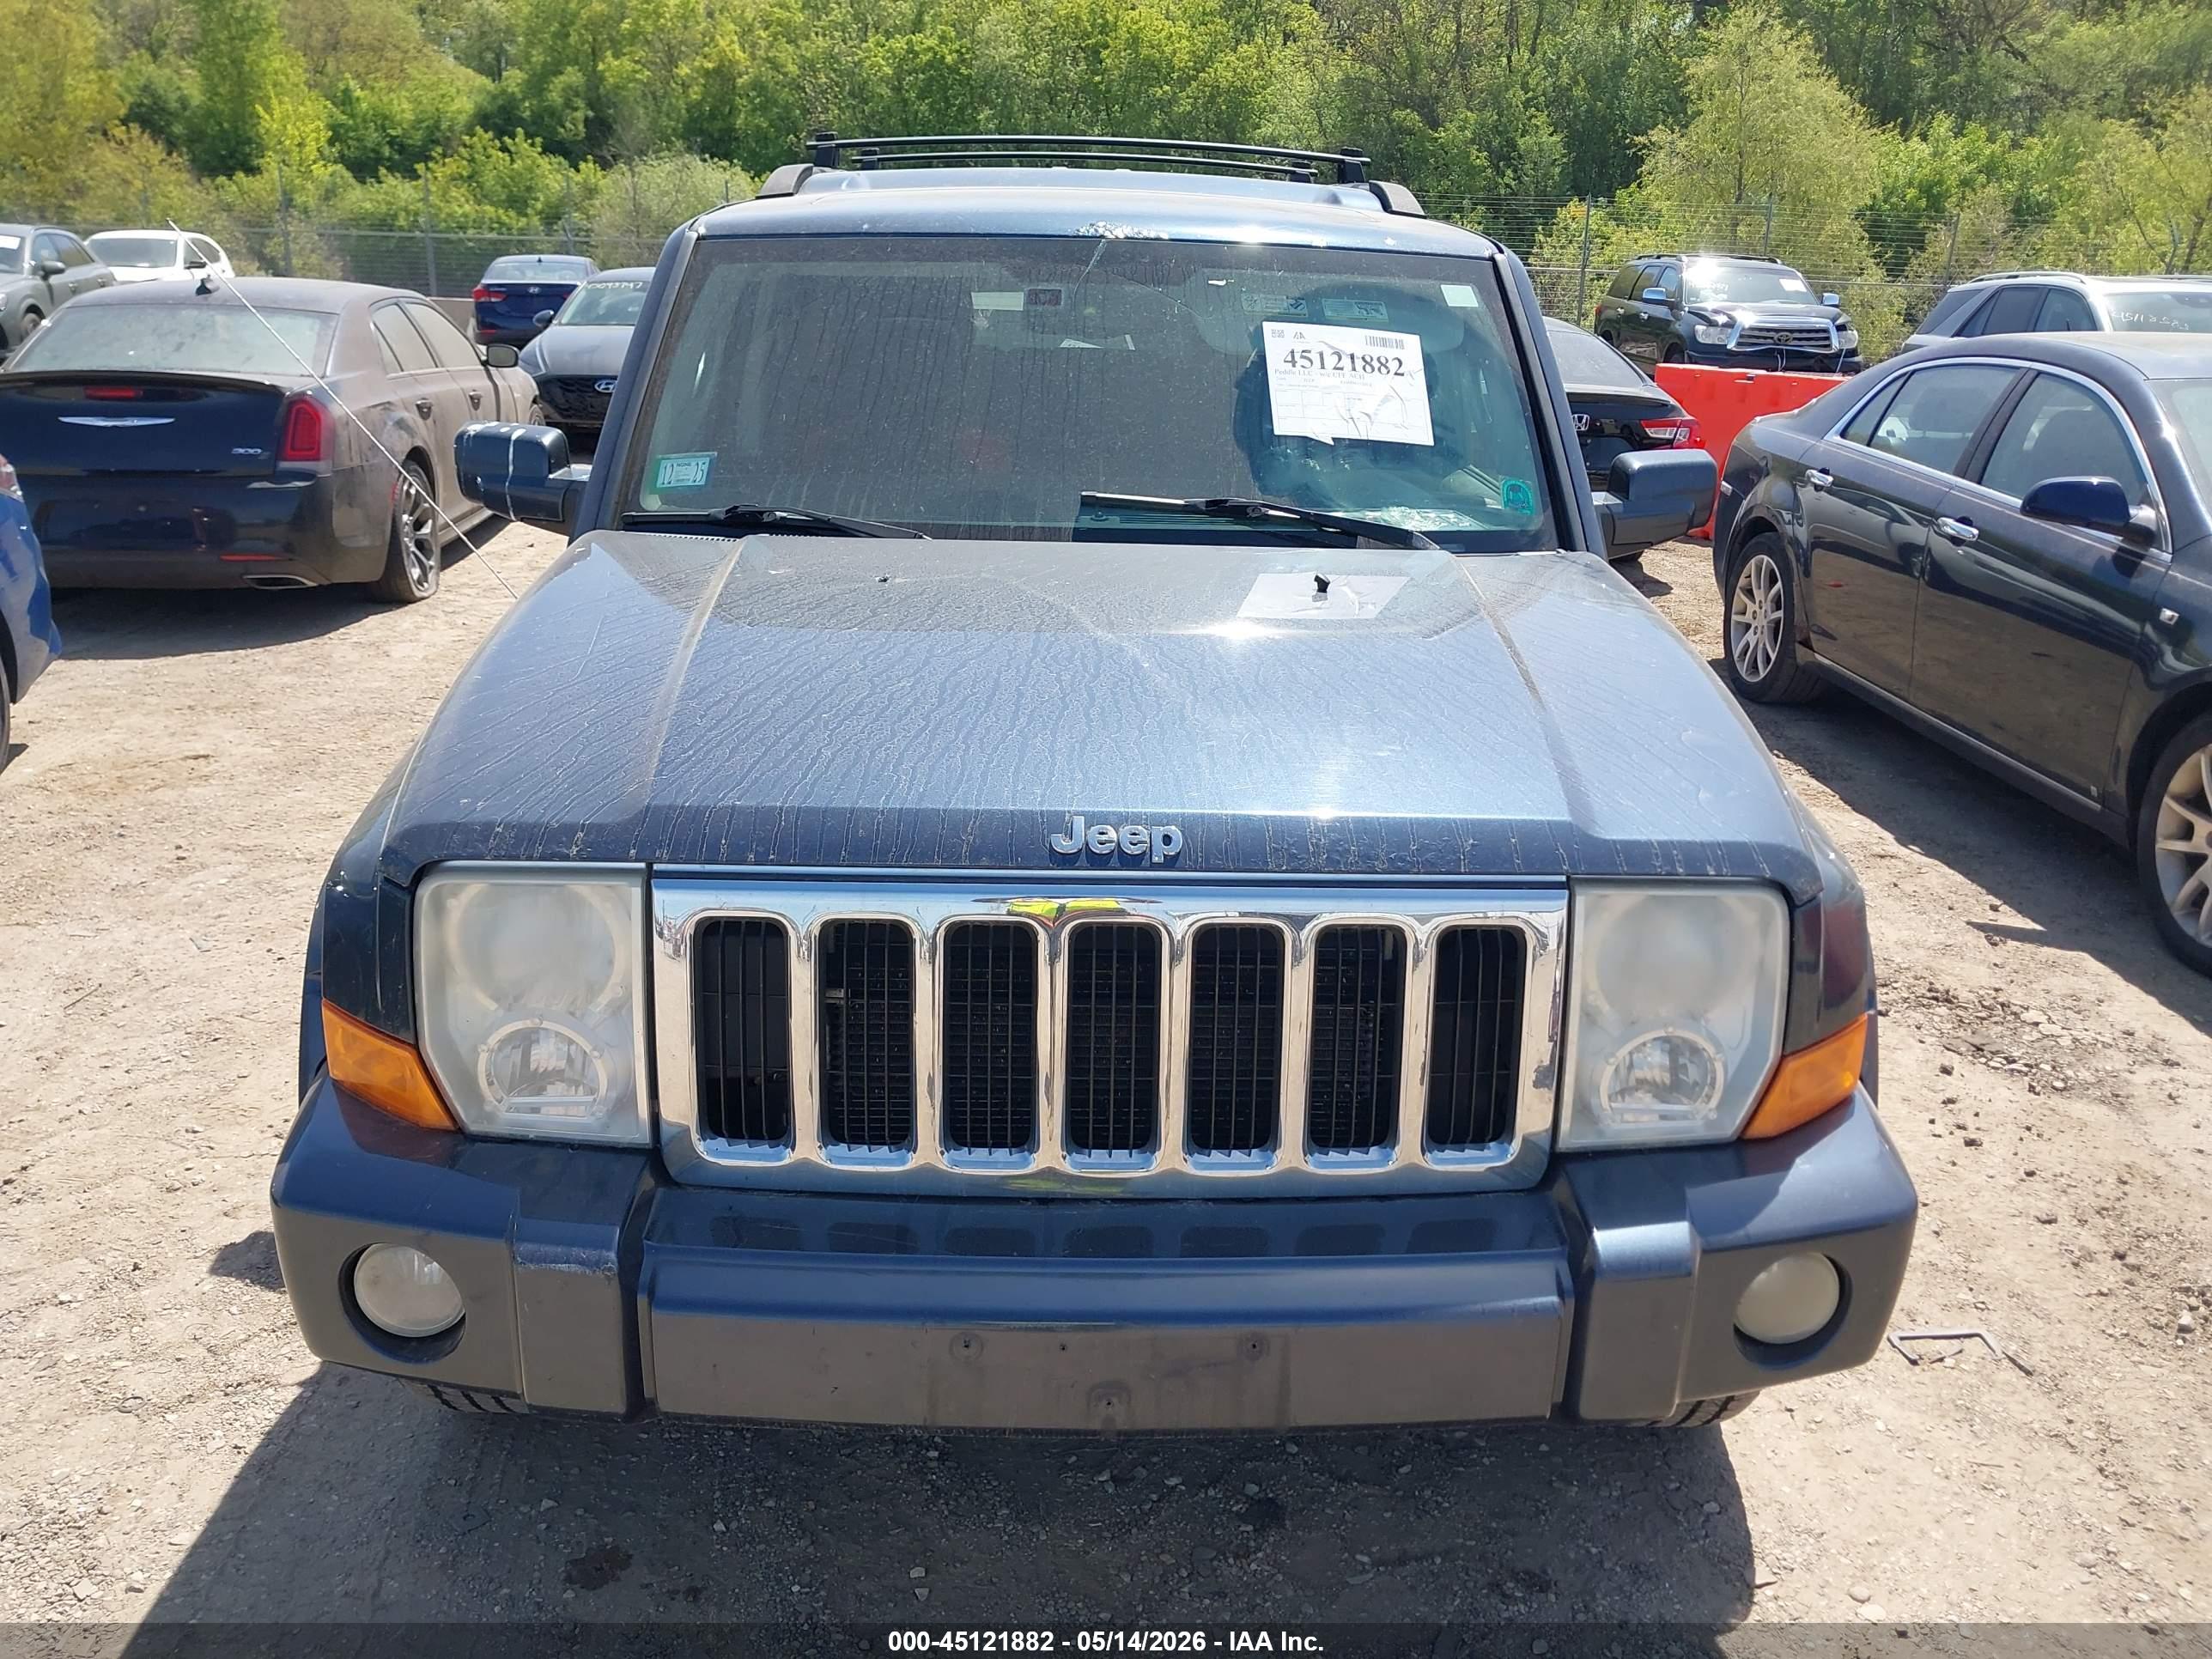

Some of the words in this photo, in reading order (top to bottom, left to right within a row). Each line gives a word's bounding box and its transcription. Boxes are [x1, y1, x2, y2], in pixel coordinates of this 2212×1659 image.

[1283, 348, 1405, 377] 45121882
[662, 463, 674, 485] 12
[693, 461, 707, 483] 25
[1050, 816, 1183, 864] Jeep
